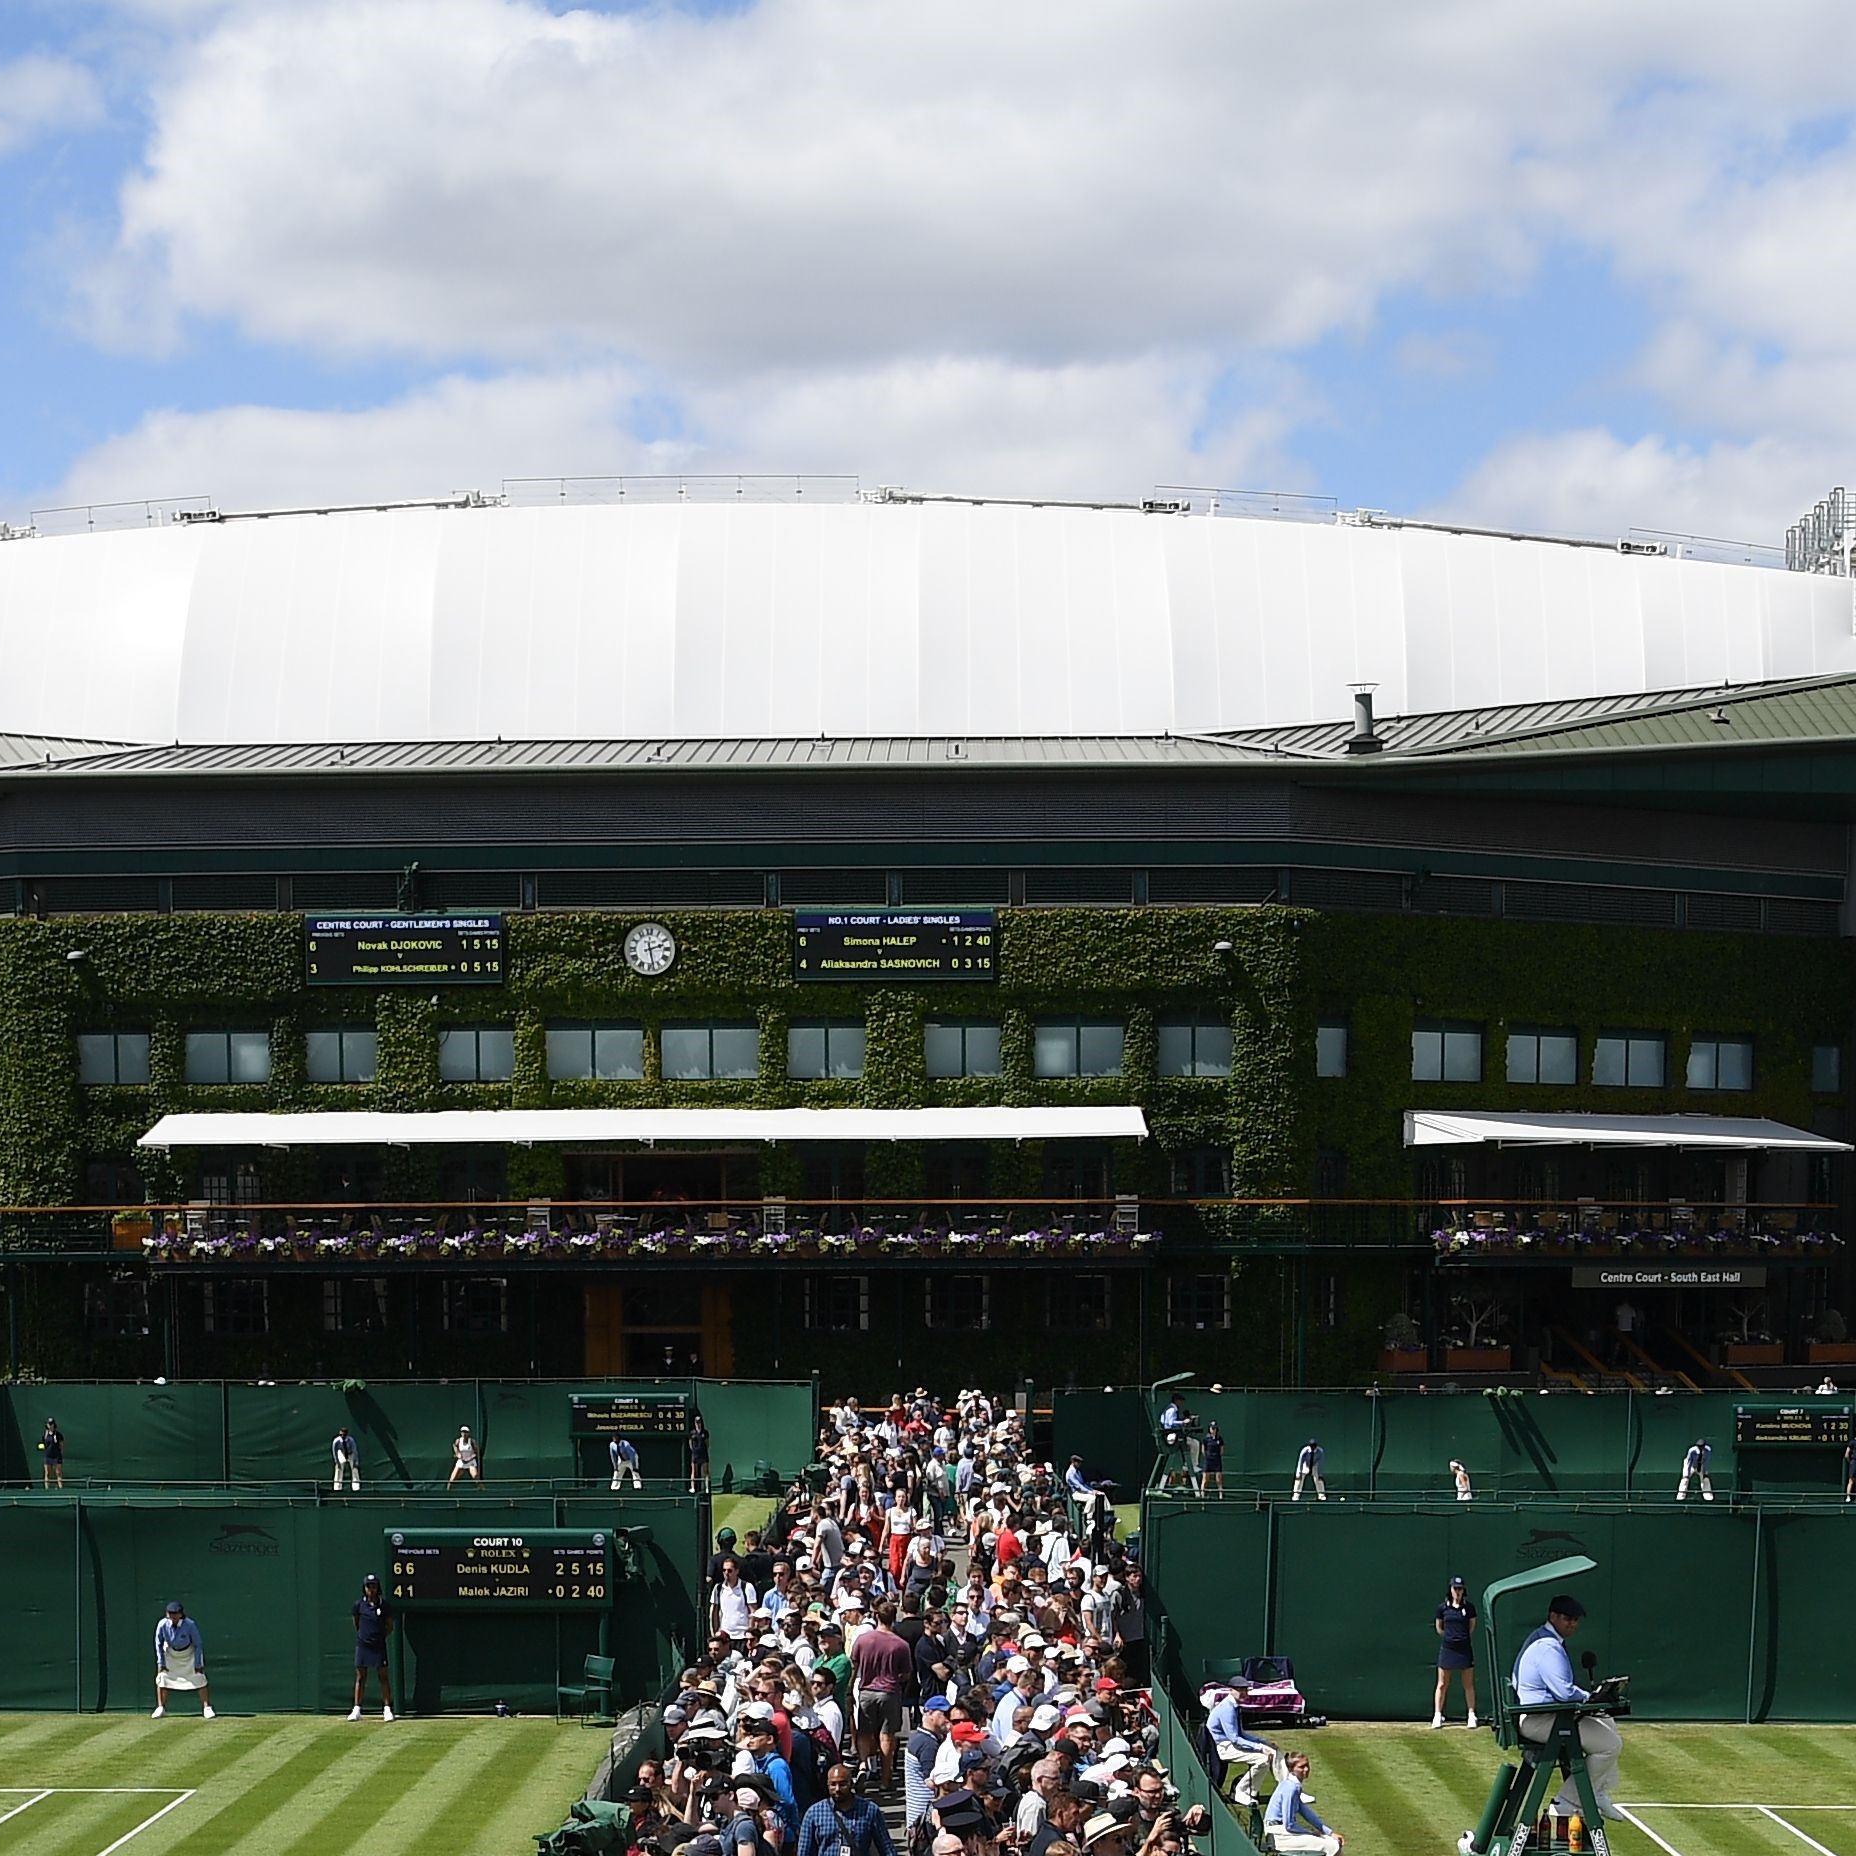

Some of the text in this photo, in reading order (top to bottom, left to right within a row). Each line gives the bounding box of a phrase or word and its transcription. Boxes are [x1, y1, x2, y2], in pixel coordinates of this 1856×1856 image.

[317, 920, 489, 929] CENTRE COURT GENTLEMEN'S SINGLES
[888, 916, 920, 924] LADIES'
[923, 916, 960, 924] SINGLES
[309, 940, 499, 952] 6 Novak DJOKOVIC 1 5 15
[799, 936, 990, 946] 6 Simona HALEP 1 2 40
[310, 964, 317, 973] 3
[461, 963, 467, 972] 0
[474, 962, 480, 972] 5
[485, 962, 499, 971] 15
[800, 959, 807, 968] 4
[880, 959, 940, 968] SASNOVICH
[952, 959, 958, 968] 0
[965, 959, 971, 968] 3
[977, 959, 990, 968] 15
[1600, 1272, 1741, 1283] Centre Court South East Hall
[473, 1538, 523, 1546] COURT 10
[209, 1542, 280, 1556] Slazenger
[481, 1549, 516, 1558] ROLEX
[393, 1563, 604, 1575] 6 6 Denis KUDLA 2 5 15
[394, 1585, 604, 1597] 4 1 Malek JAZIRI 0 2 40
